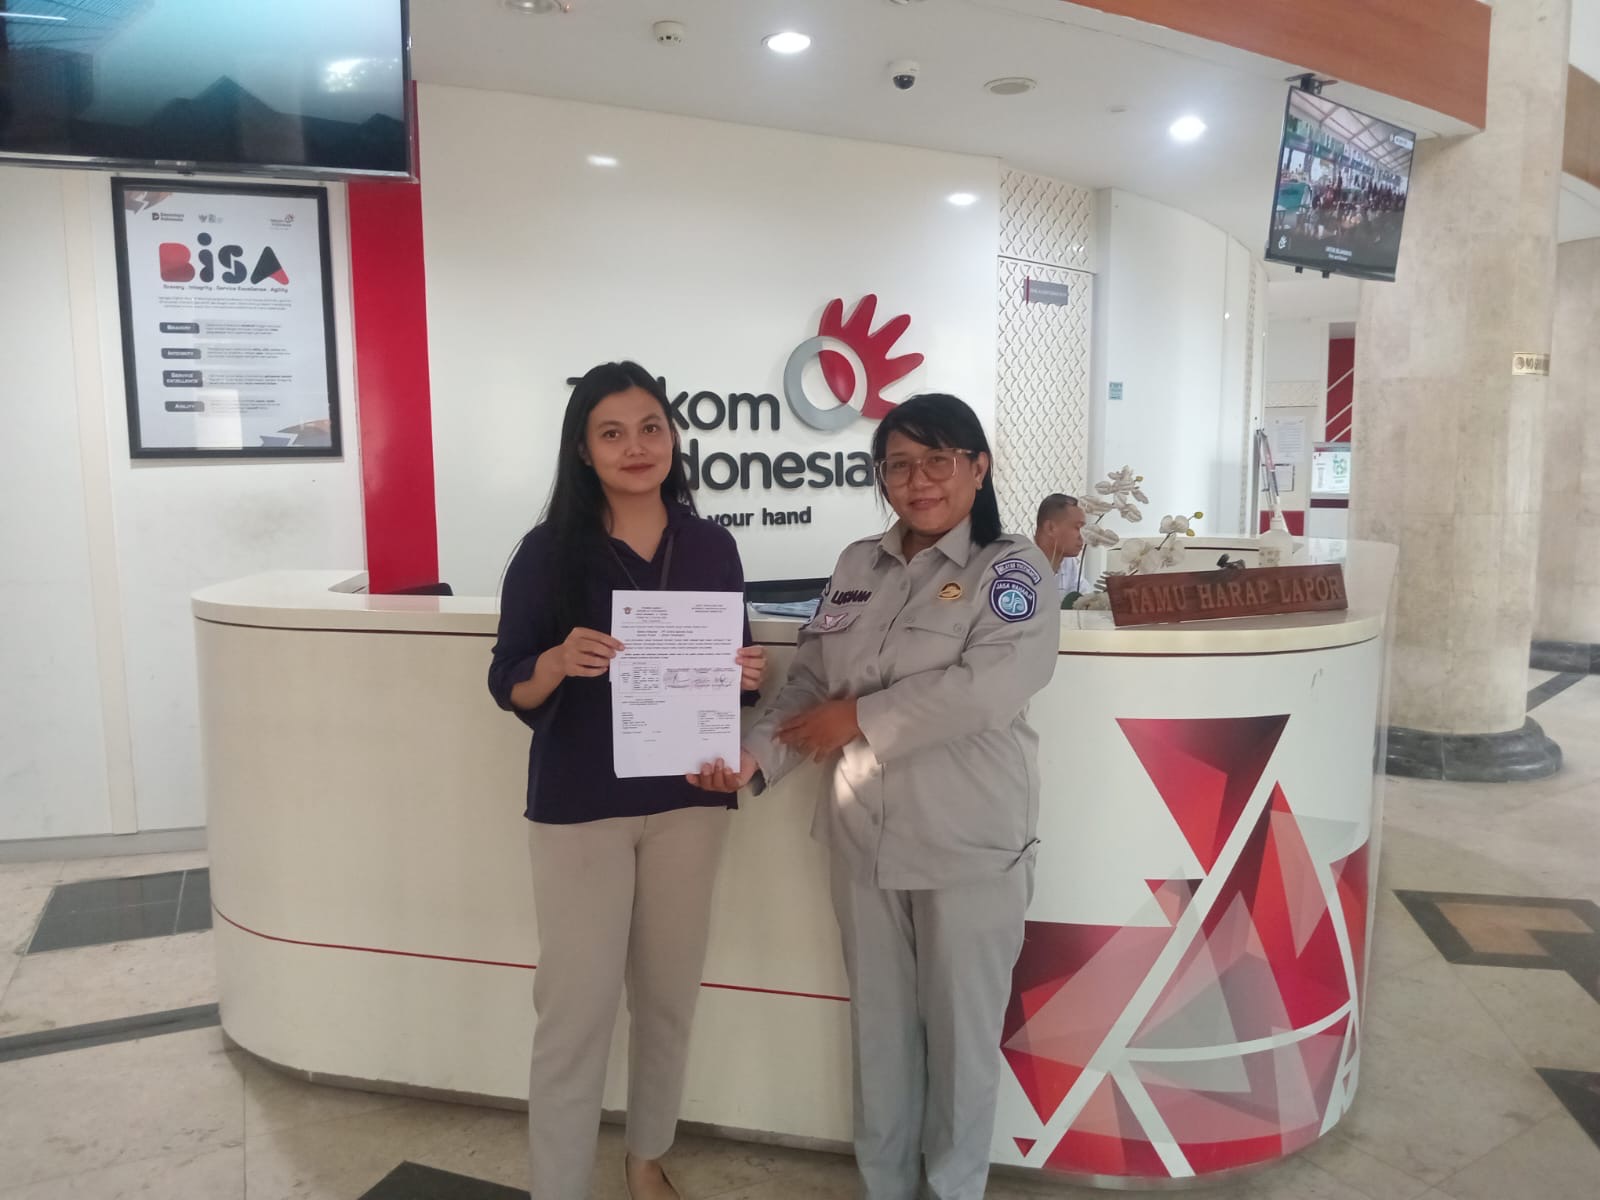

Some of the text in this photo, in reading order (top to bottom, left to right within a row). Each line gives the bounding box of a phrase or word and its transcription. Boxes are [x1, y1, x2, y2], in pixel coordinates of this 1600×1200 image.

[681, 438, 874, 490] donesia
[762, 506, 812, 525] hand
[996, 582, 1010, 590] JASA
[1124, 575, 1345, 614] TAMU HARAP LAPOR
